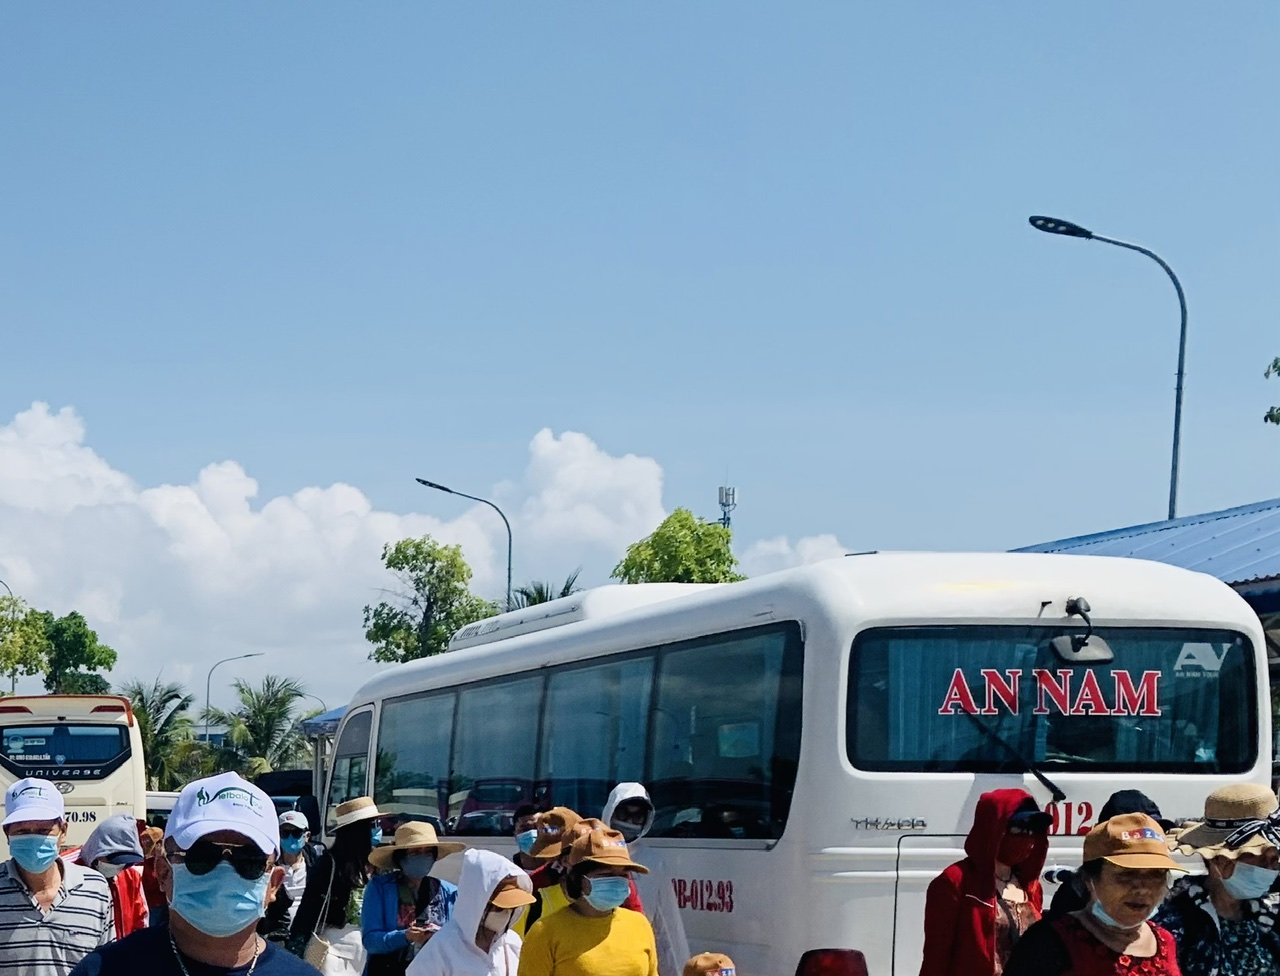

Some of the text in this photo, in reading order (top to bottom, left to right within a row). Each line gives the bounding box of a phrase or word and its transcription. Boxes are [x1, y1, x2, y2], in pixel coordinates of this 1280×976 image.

[938, 668, 1162, 717] AN NAM
[25, 769, 102, 777] UNIVERSE
